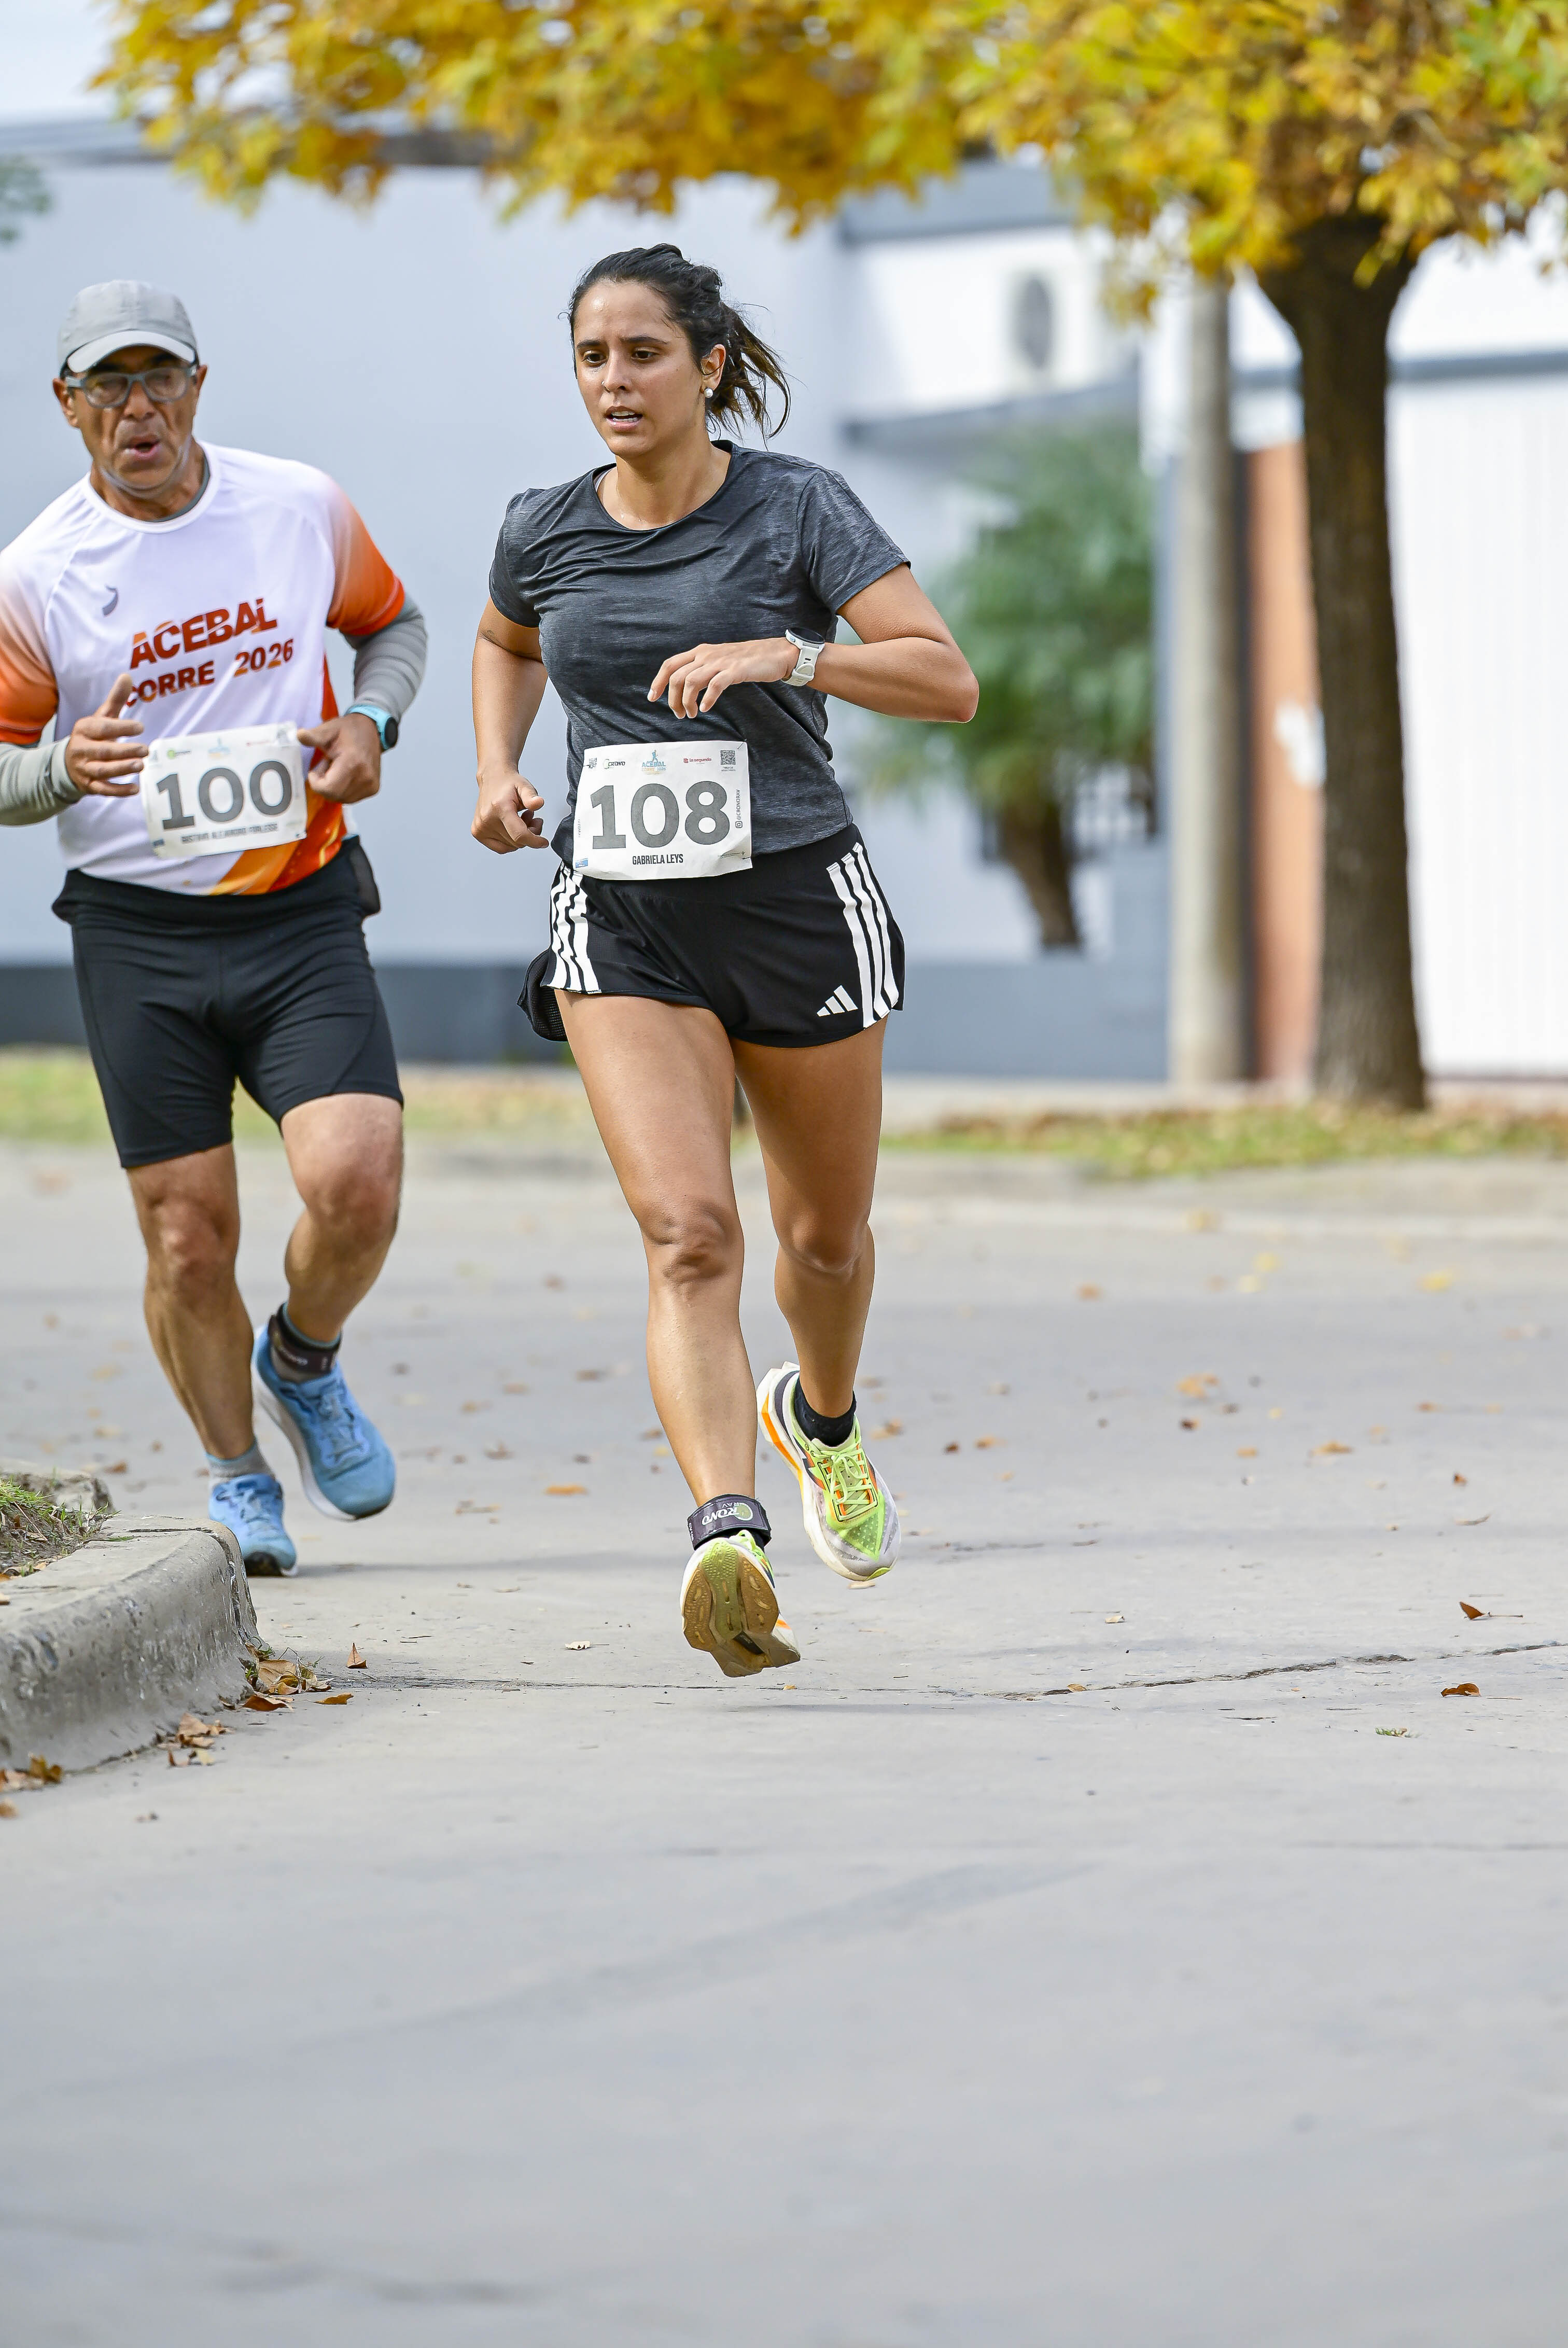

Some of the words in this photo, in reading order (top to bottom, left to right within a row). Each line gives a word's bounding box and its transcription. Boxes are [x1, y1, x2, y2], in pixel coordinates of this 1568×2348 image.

[130, 598, 277, 670] ACEBAL
[234, 639, 294, 677] 2026
[157, 761, 292, 830] 100
[591, 780, 730, 849] 108
[633, 855, 665, 864] GABRIELA
[666, 854, 683, 863] LEYS
